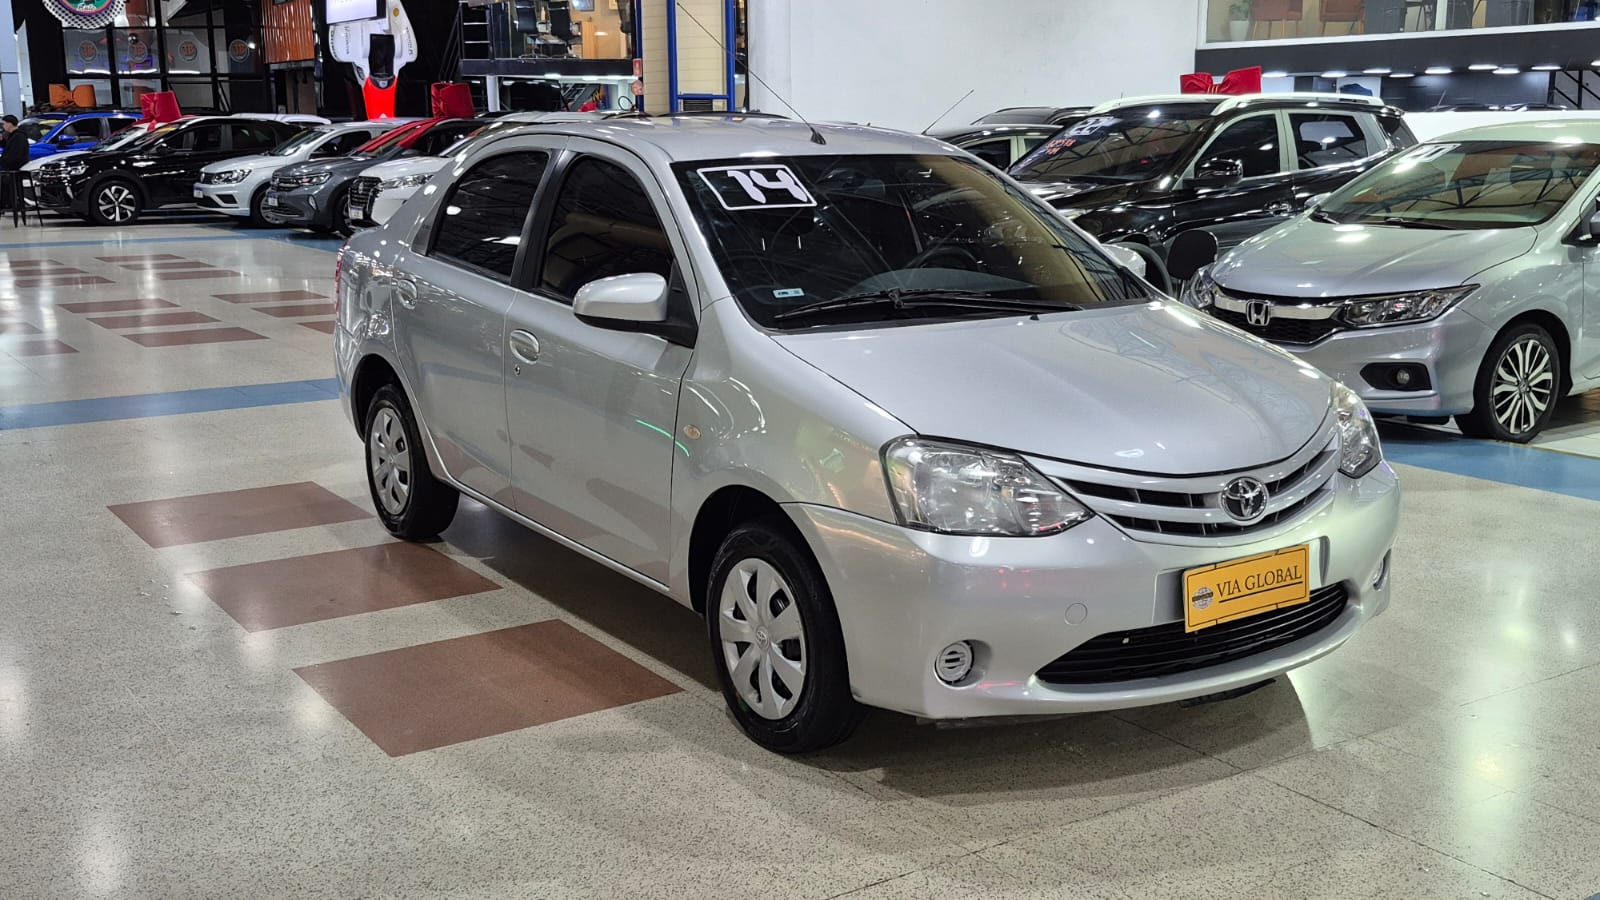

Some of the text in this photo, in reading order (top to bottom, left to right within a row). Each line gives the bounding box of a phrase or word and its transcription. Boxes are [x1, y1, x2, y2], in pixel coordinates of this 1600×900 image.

[727, 169, 808, 204] 14
[1217, 565, 1303, 597] VIA GLOBAL
